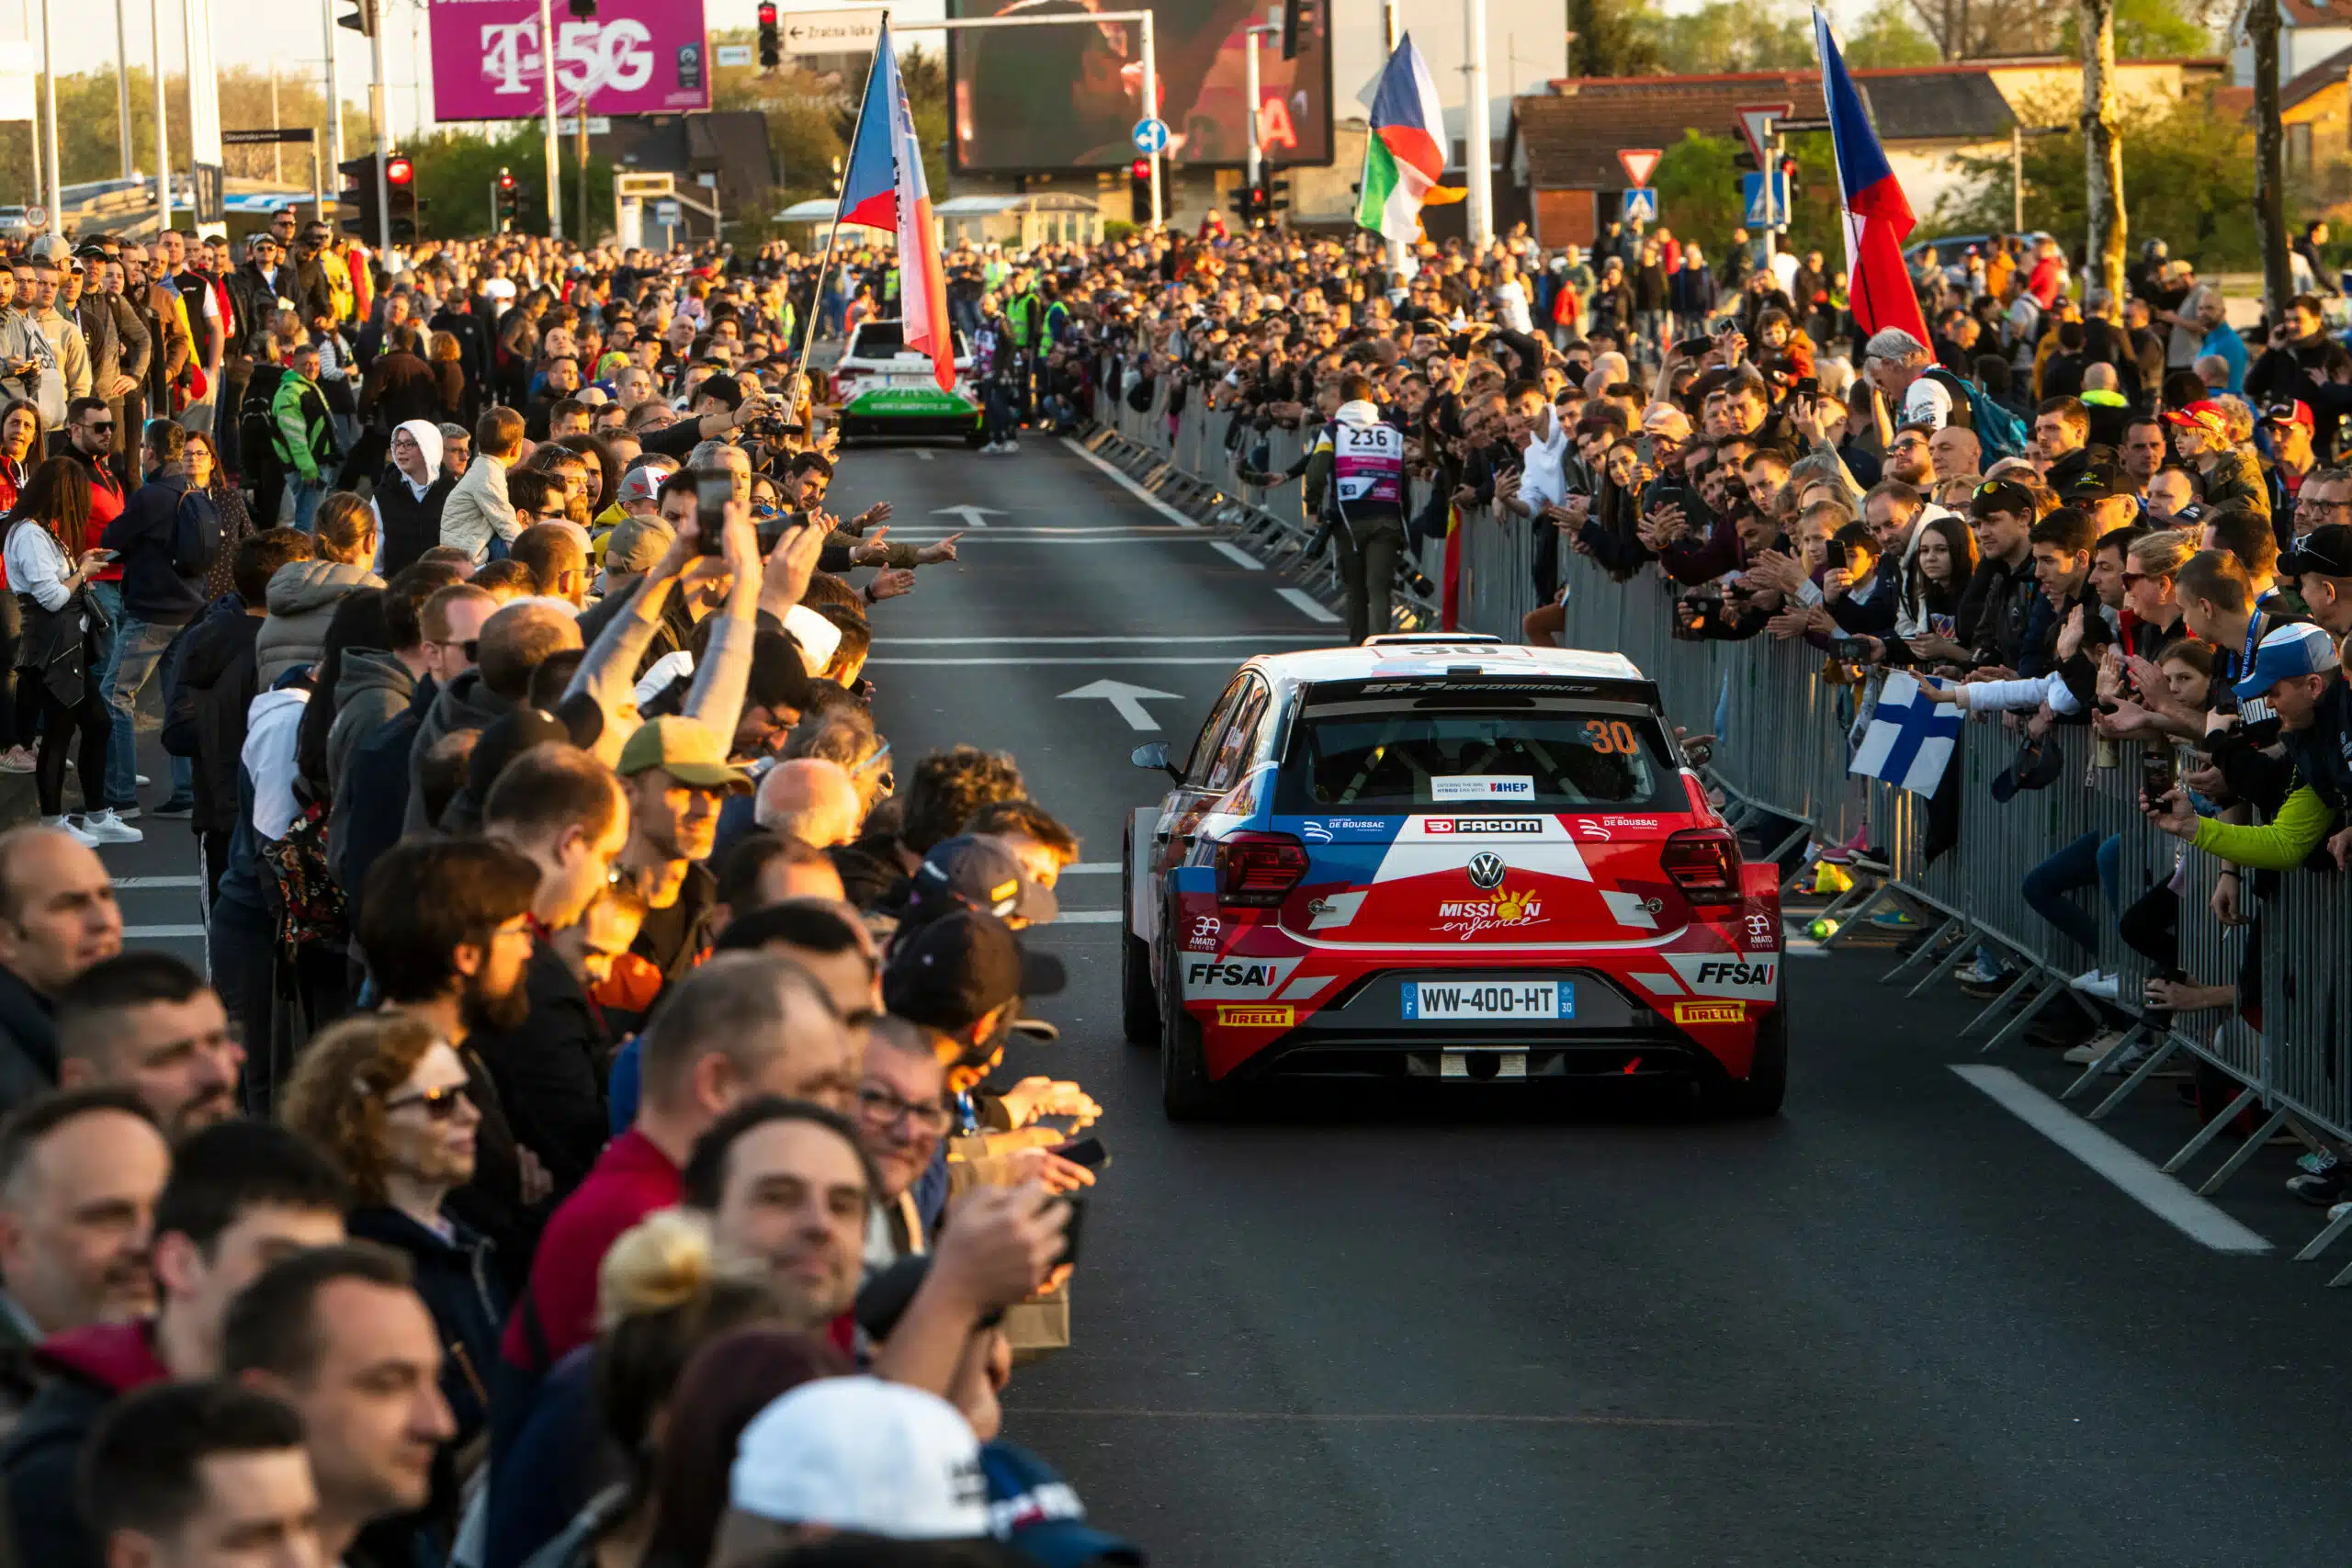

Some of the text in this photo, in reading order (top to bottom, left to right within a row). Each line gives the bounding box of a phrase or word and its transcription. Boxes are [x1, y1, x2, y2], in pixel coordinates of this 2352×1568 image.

[556, 18, 653, 92] 5G
[1350, 428, 1388, 446] 236
[2242, 637, 2253, 664] CROATIA
[1586, 720, 1638, 755] 30
[1503, 783, 1529, 792] HEP
[1458, 820, 1540, 832] FACOM
[1430, 917, 1551, 941] enfance
[1190, 937, 1216, 946] AMATO
[1750, 935, 1773, 944] AMATO
[1188, 964, 1266, 987] FFSA
[1696, 962, 1767, 986] FFSA
[1406, 987, 1572, 1015] F WW-400-HT 30
[1223, 1008, 1288, 1024] PIRELLI
[1680, 1003, 1741, 1021] PIRELLI
